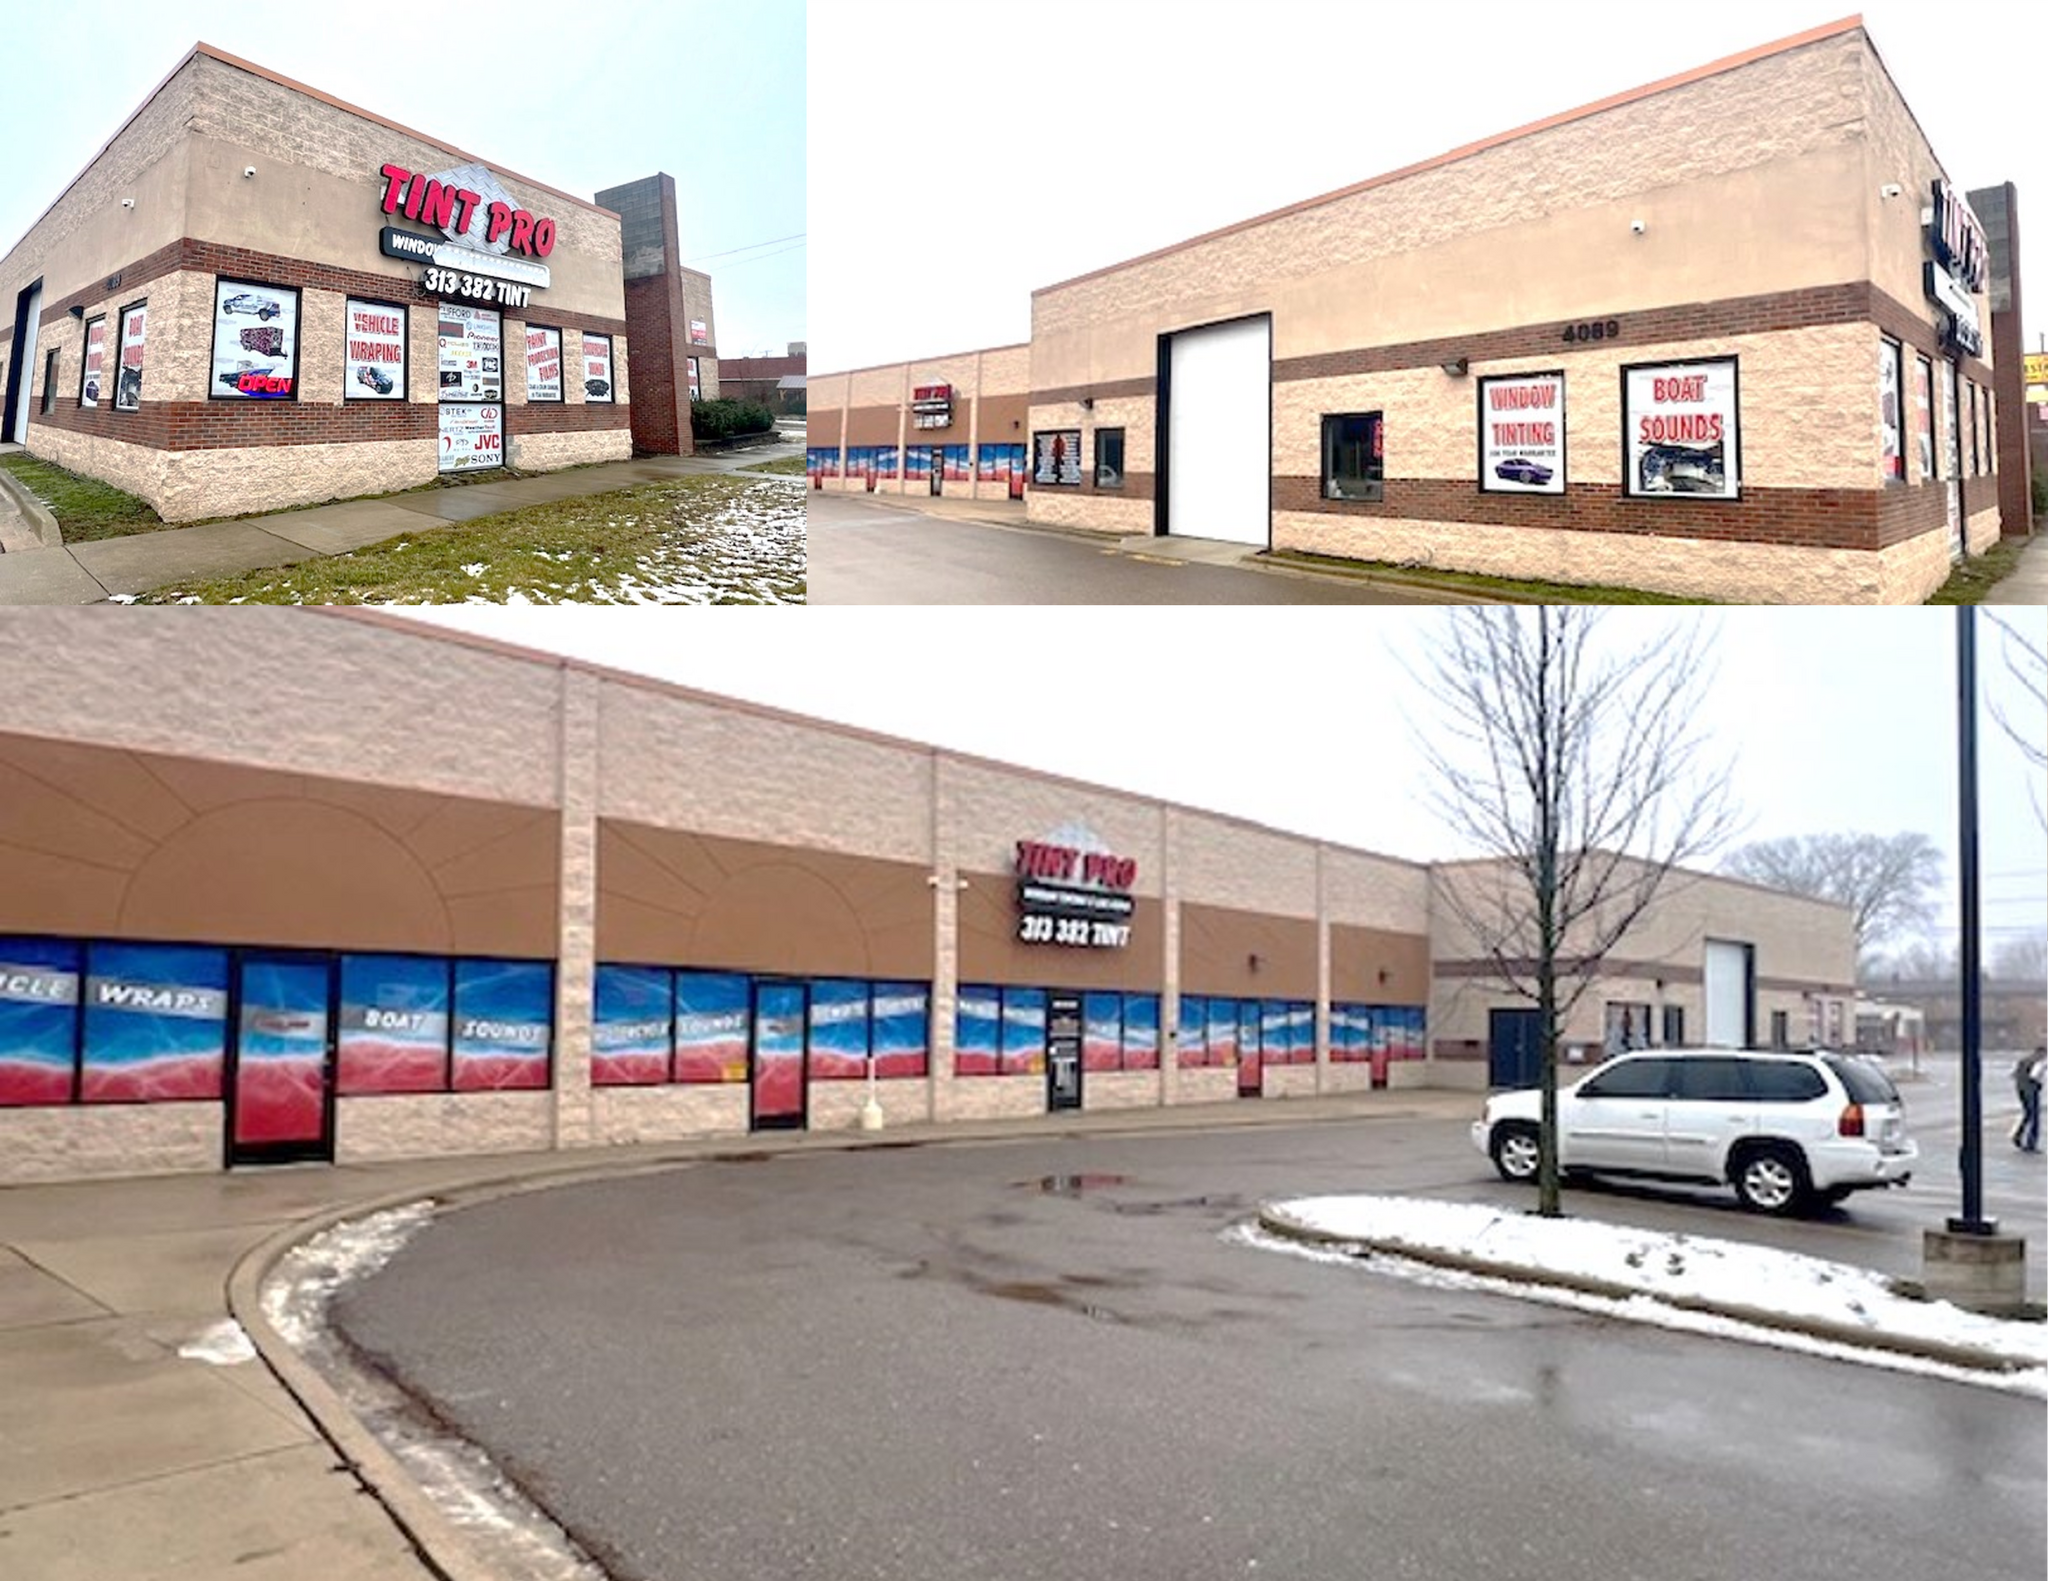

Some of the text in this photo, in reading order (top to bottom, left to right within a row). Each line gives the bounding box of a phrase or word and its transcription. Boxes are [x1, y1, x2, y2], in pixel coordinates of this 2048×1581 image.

[381, 163, 556, 258] TINT PRO
[425, 268, 531, 308] 313 382 TINT
[353, 312, 400, 336] VEHICLE
[1563, 320, 1619, 343] 4089
[350, 340, 401, 364] WRAPING
[527, 331, 546, 350] PAINT
[238, 373, 292, 393] OPEN
[1653, 374, 1708, 404] BOAT
[1489, 384, 1556, 411] WINDOW
[1492, 422, 1555, 446] TINTING
[1639, 414, 1724, 443] SOUNDS
[475, 434, 500, 450] JVC
[470, 453, 500, 465] SONY
[1017, 841, 1079, 880] TINT
[99, 983, 211, 1012] WRAPS
[365, 1010, 542, 1042] BOAT SOUNDS
